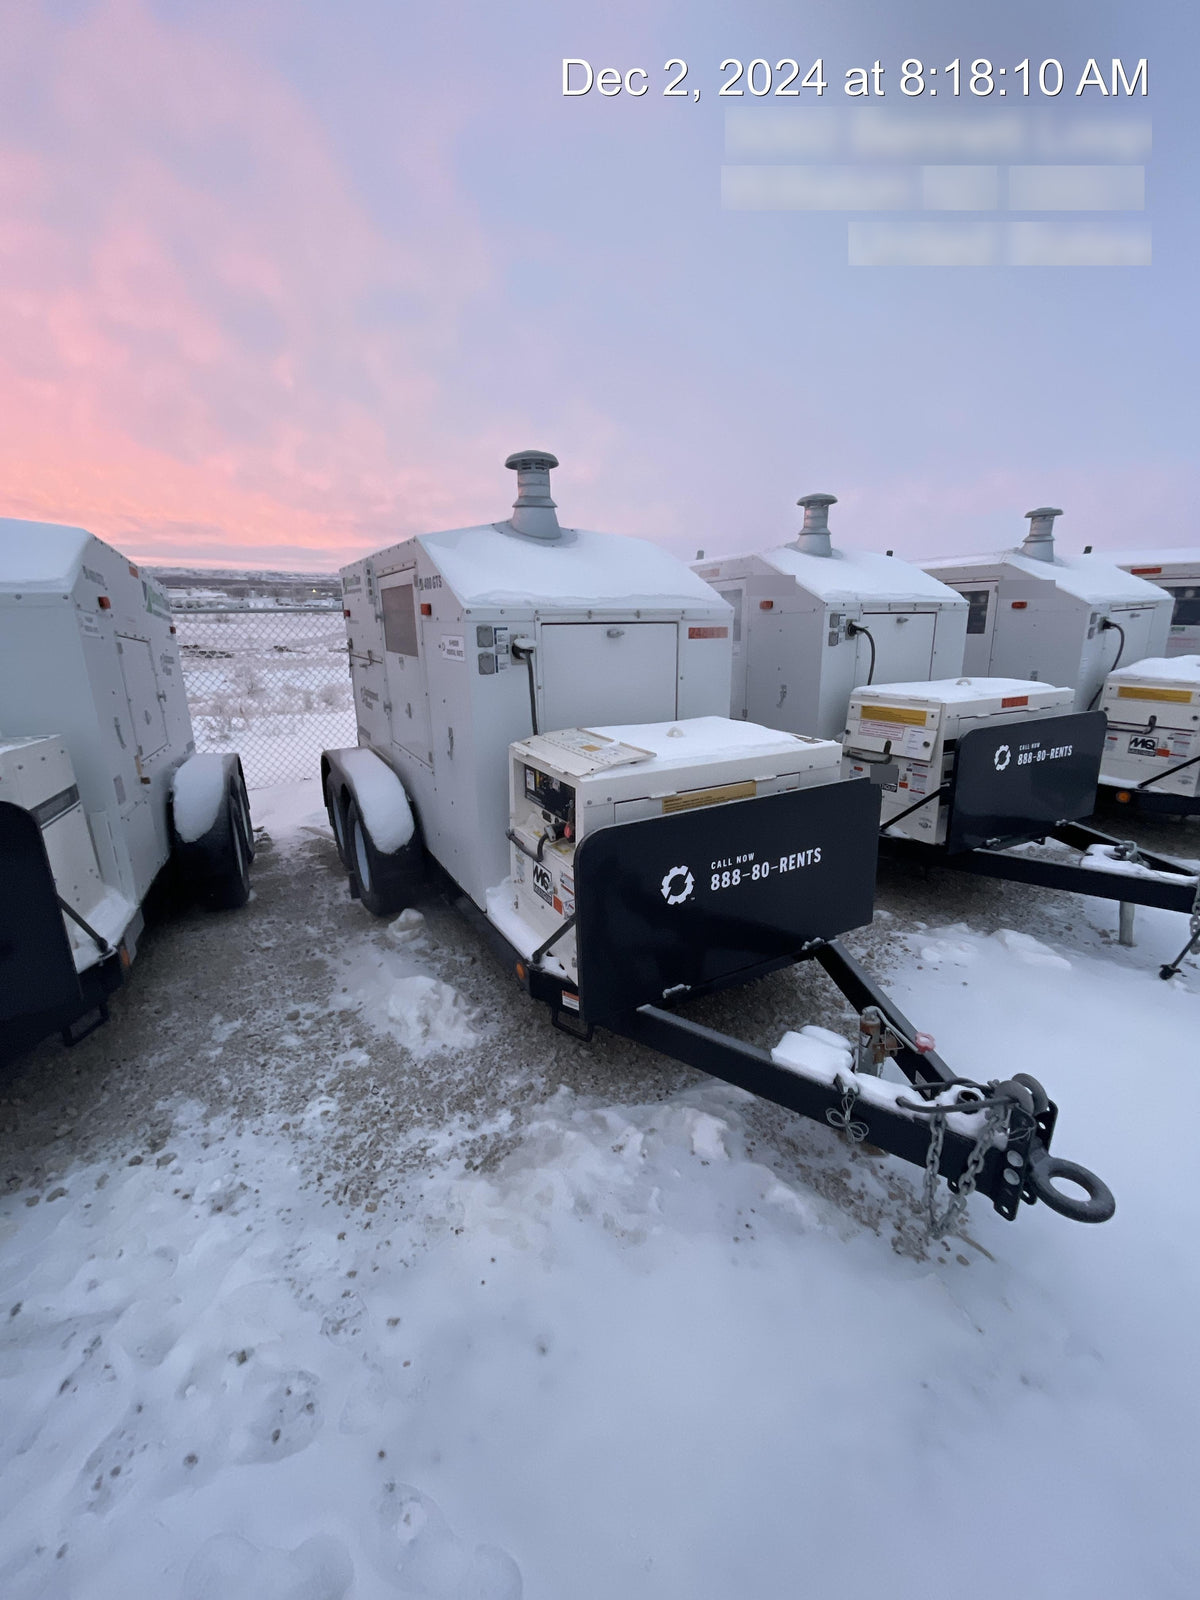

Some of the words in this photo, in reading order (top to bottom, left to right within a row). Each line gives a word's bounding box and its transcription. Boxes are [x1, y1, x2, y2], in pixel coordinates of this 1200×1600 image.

[1129, 737, 1156, 750] MQ
[1017, 745, 1073, 765] 888-80-RENTS
[710, 859, 733, 870] CALL
[736, 852, 755, 864] NOW
[710, 847, 822, 891] 888-80-RENTS
